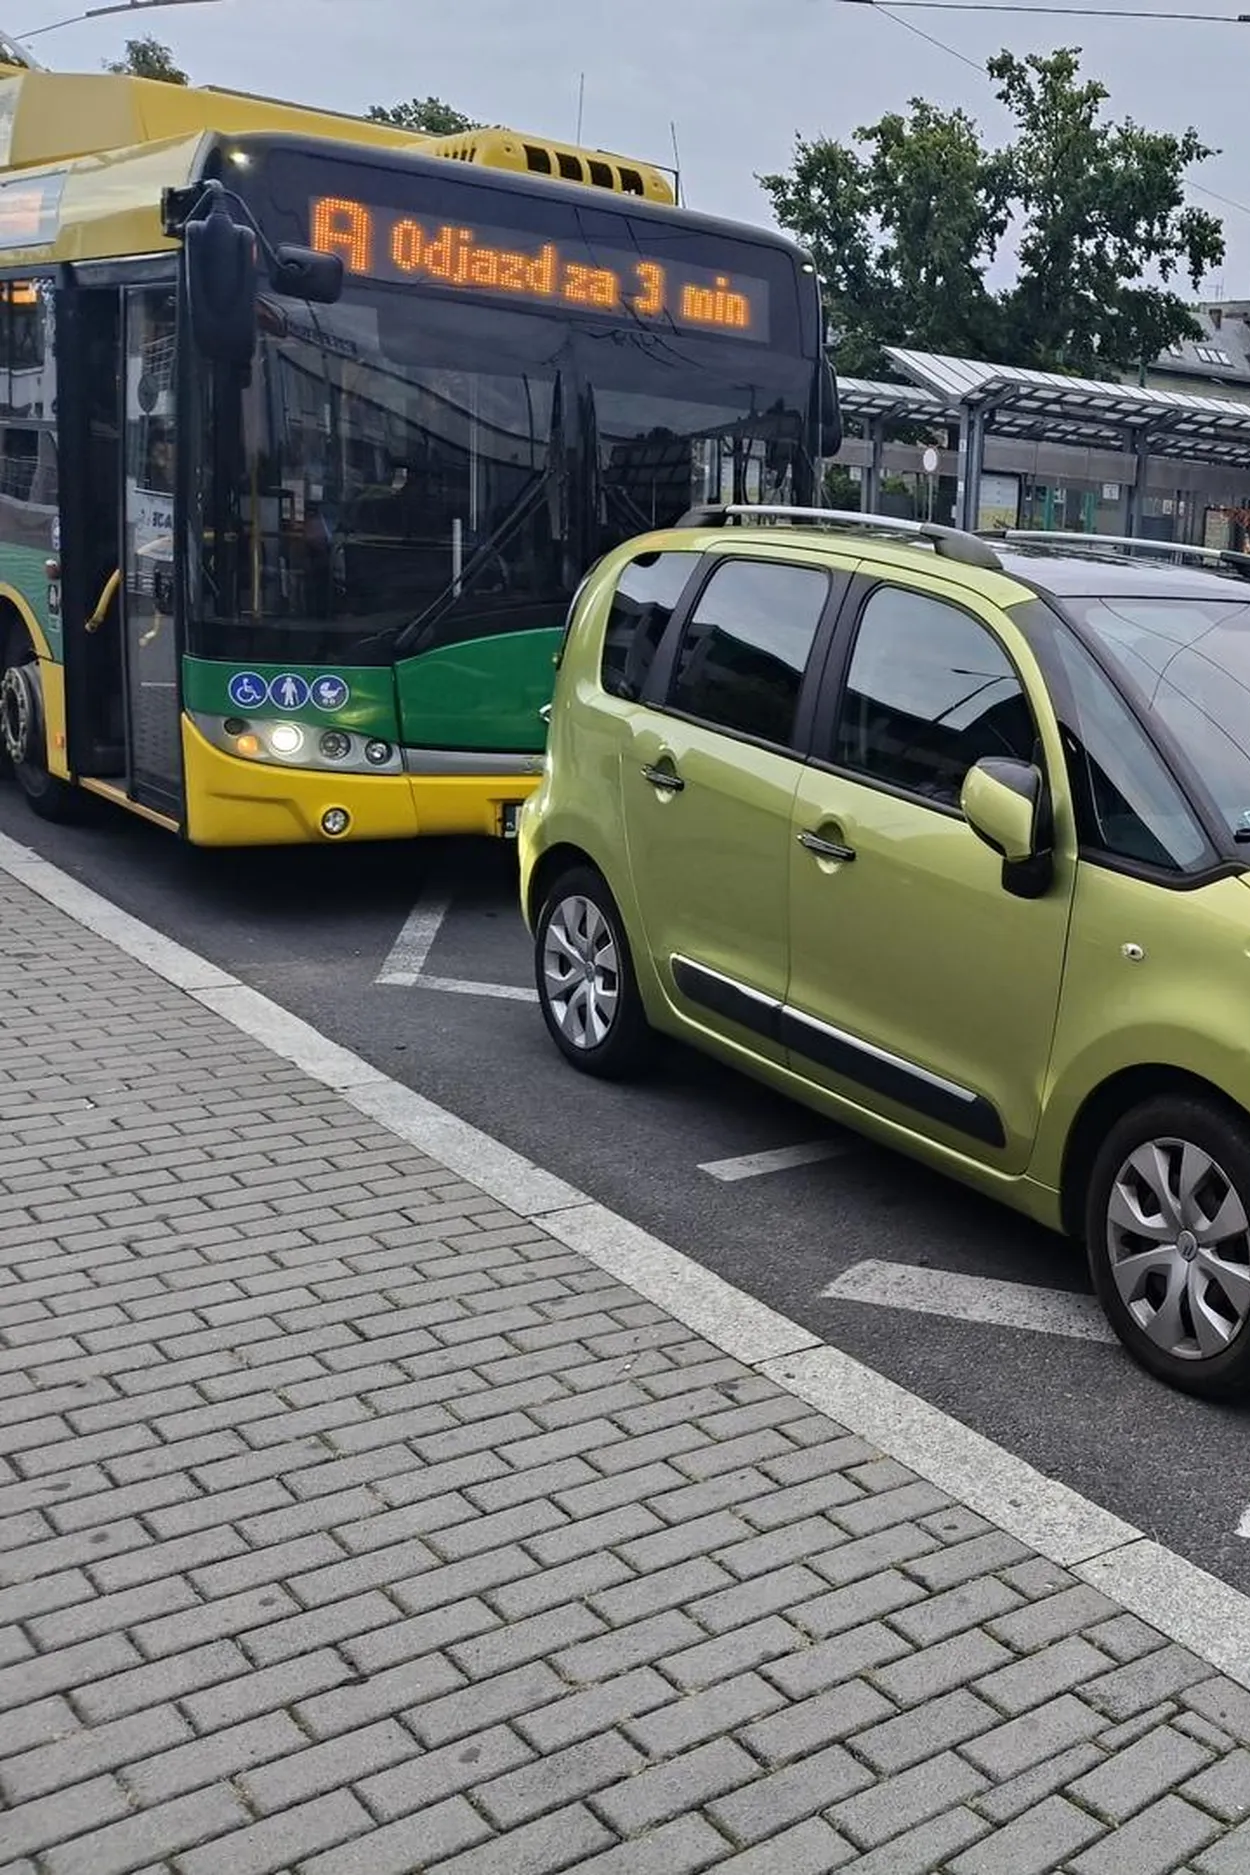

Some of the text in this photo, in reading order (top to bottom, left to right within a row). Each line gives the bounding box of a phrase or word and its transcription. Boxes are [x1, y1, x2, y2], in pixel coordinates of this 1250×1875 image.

[313, 197, 748, 328] A Odjazd za 3 min
